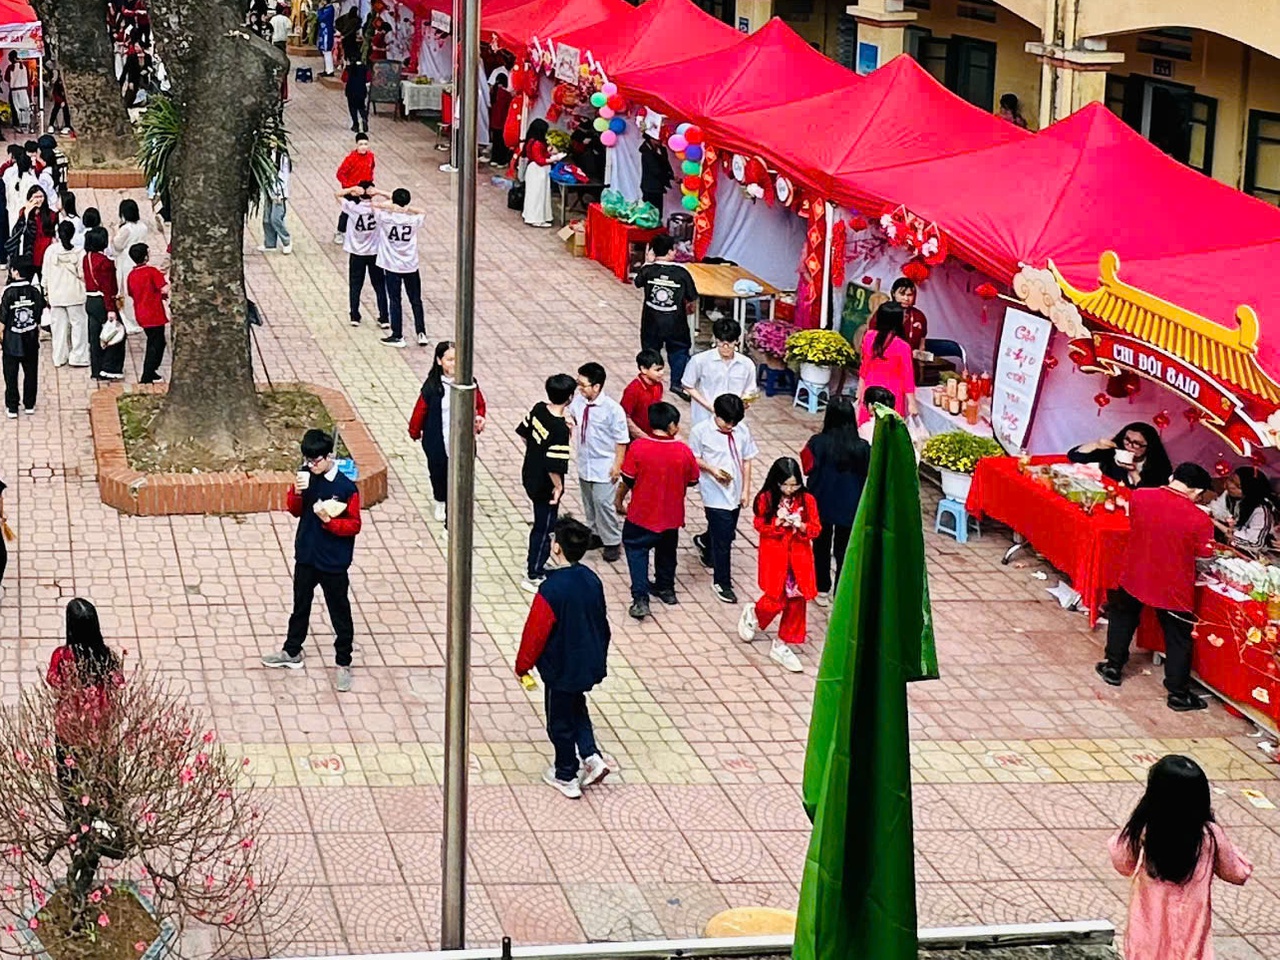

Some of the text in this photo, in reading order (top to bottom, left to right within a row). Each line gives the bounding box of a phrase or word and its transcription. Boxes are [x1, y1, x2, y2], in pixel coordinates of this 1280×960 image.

[388, 225, 412, 242] A2
[1113, 343, 1134, 365] CHI
[1138, 353, 1163, 378] ĐỘI
